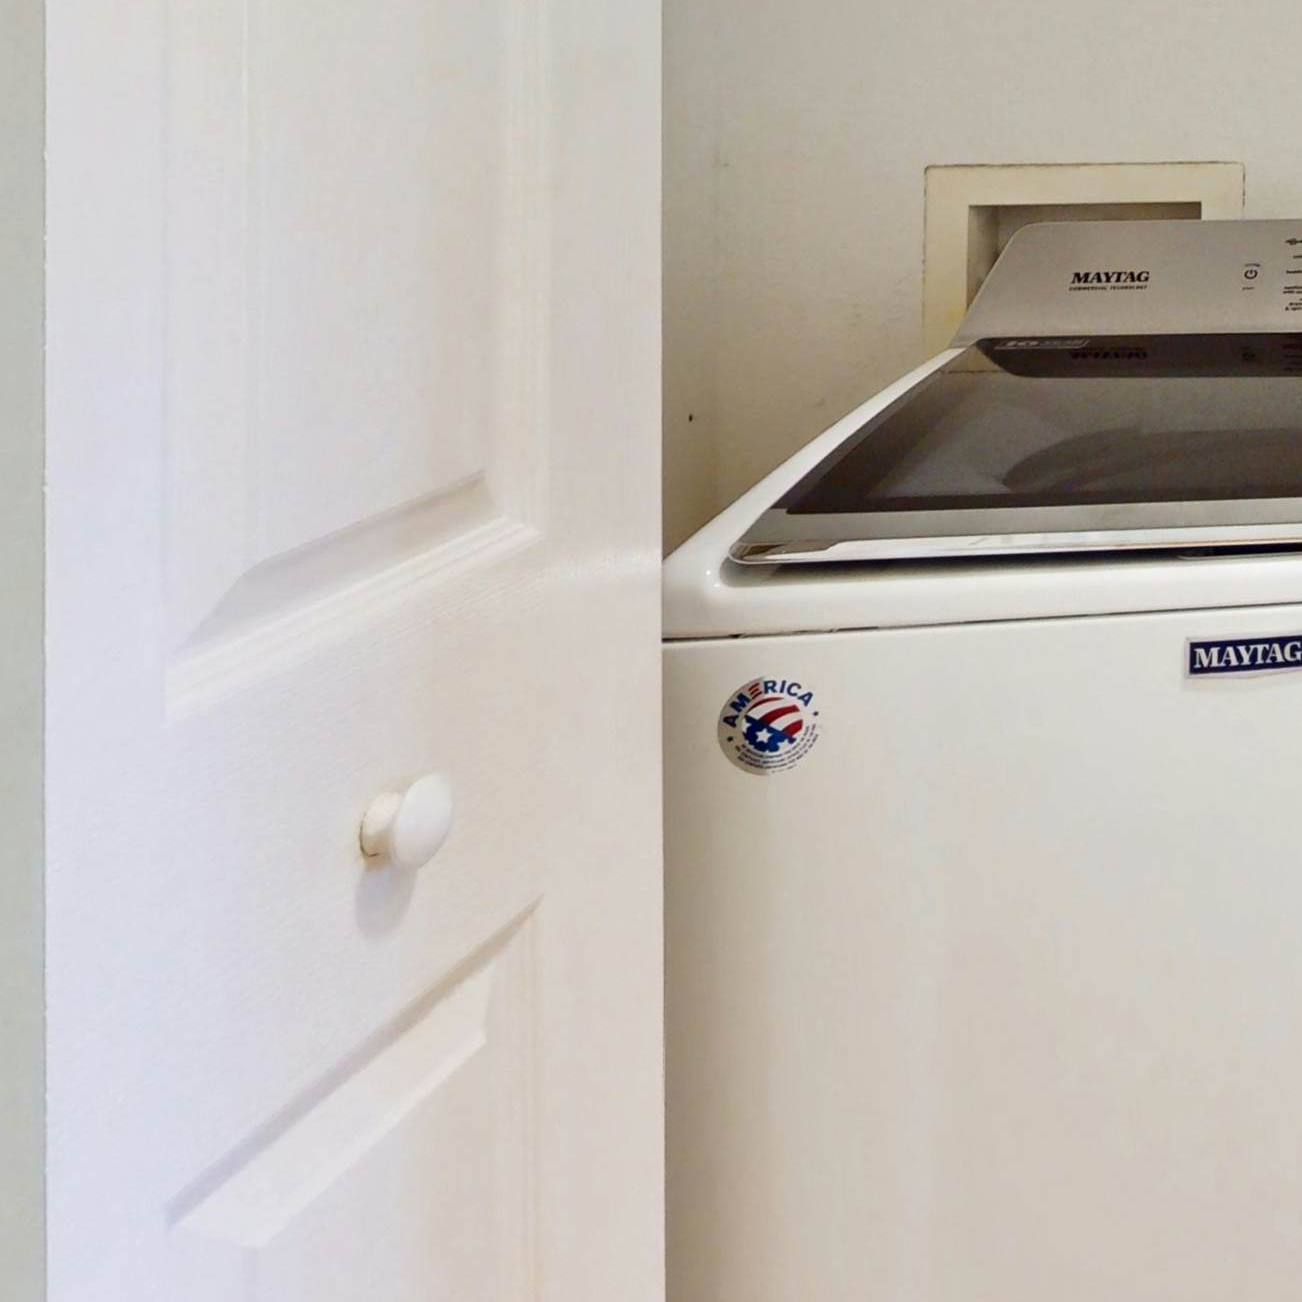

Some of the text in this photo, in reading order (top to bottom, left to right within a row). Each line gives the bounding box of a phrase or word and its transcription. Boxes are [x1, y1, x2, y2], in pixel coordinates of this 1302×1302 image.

[1071, 271, 1150, 284] MAYTAG
[1193, 641, 1302, 668] MAYTAG
[722, 680, 813, 728] AMERICA
